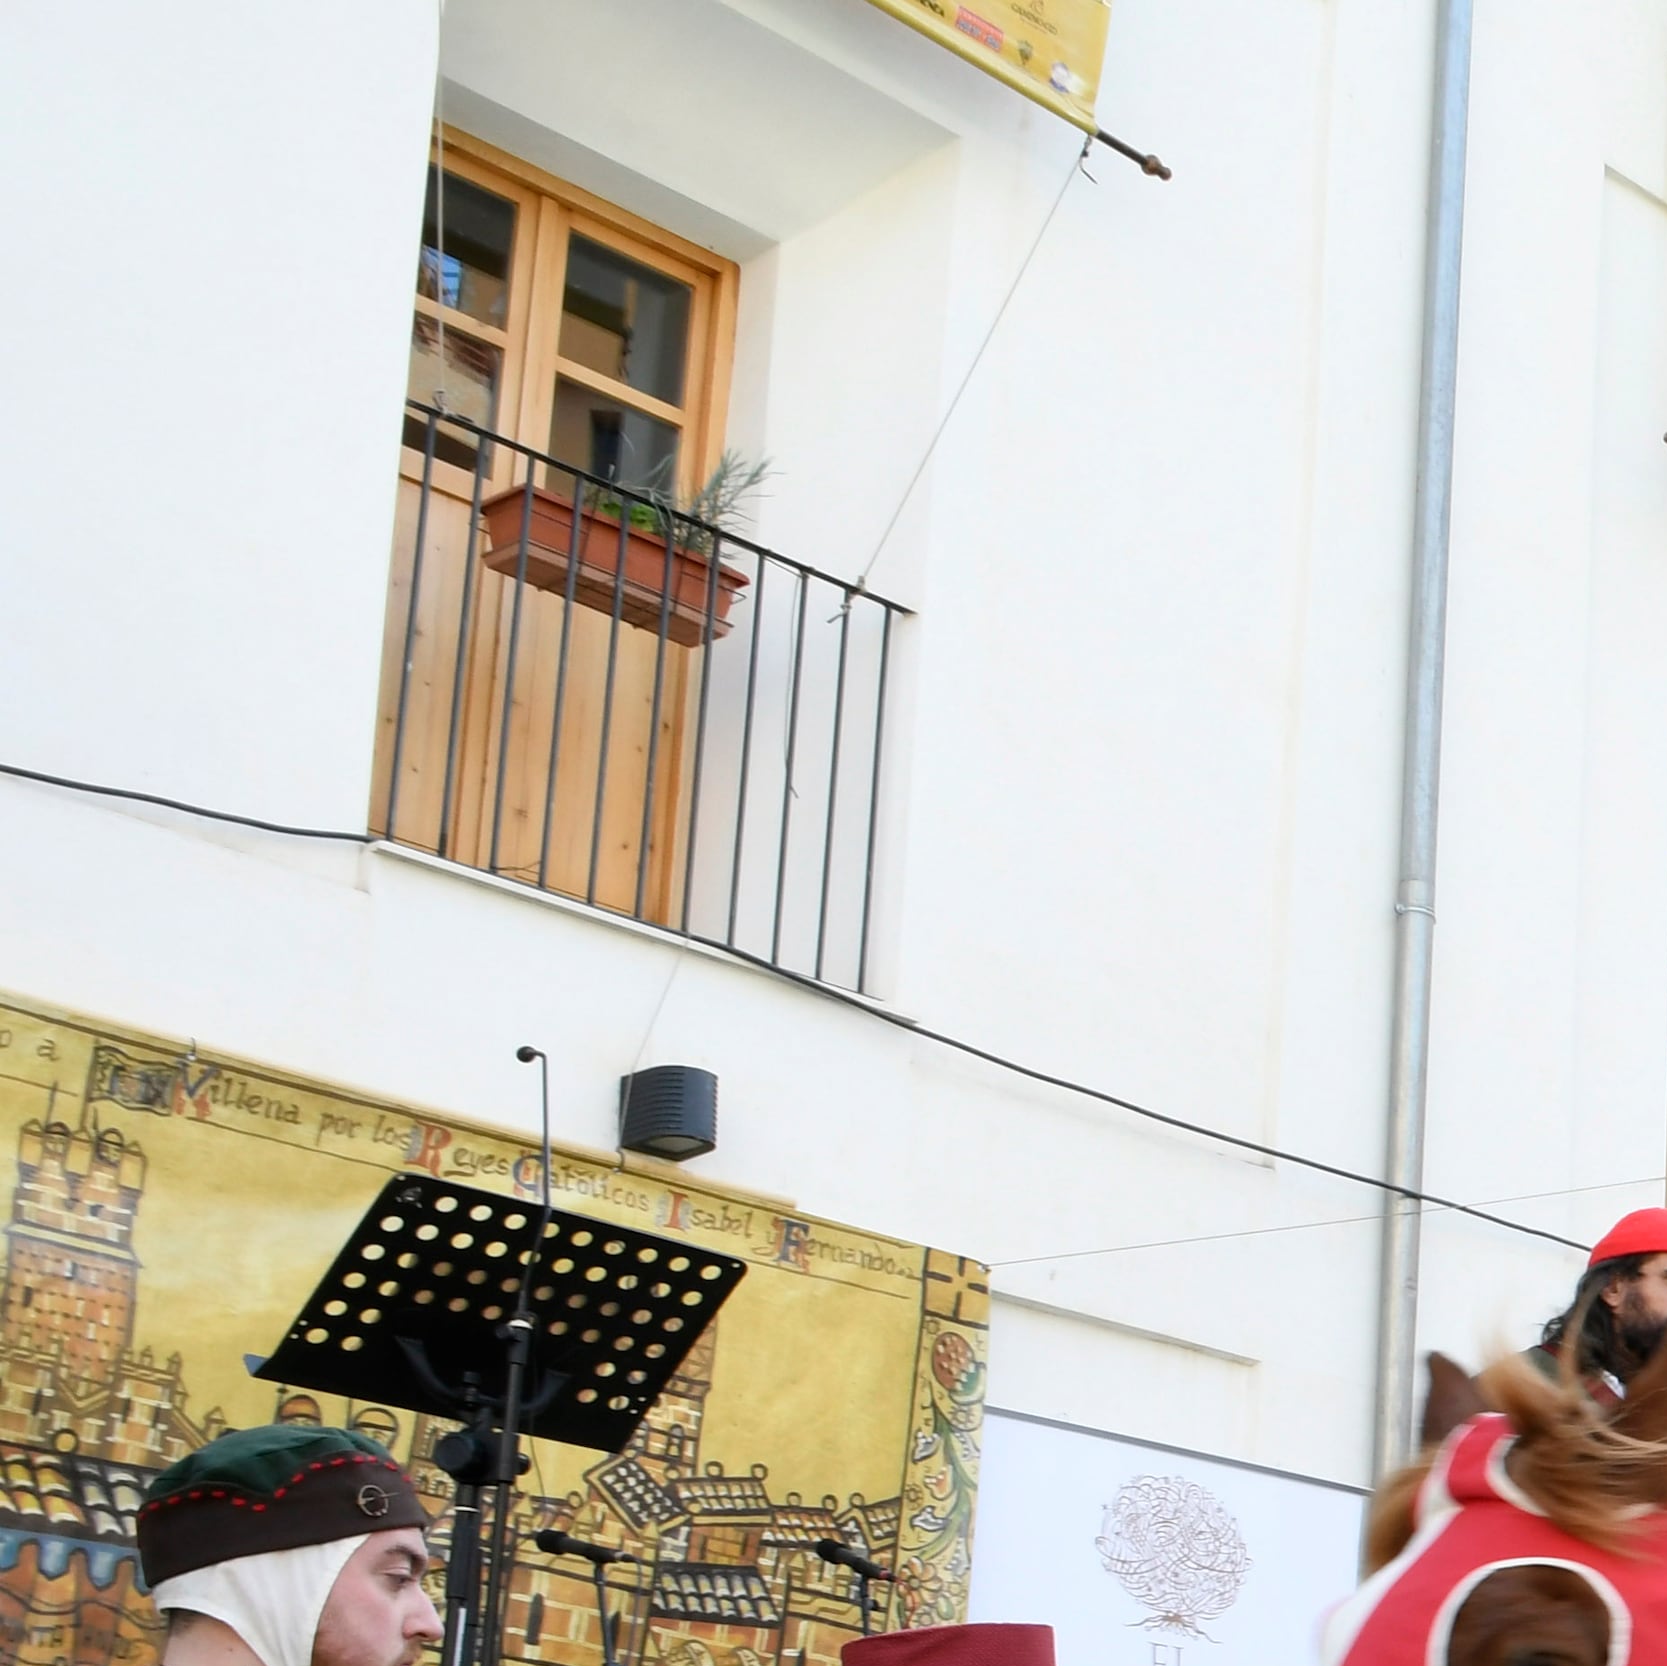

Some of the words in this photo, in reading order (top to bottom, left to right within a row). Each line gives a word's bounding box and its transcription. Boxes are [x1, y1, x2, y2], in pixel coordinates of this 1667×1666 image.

[175, 1058, 302, 1126] Villena
[317, 1109, 362, 1147] por
[373, 1114, 412, 1152] los
[405, 1119, 511, 1178] Reyes
[666, 1188, 754, 1241] Isabel
